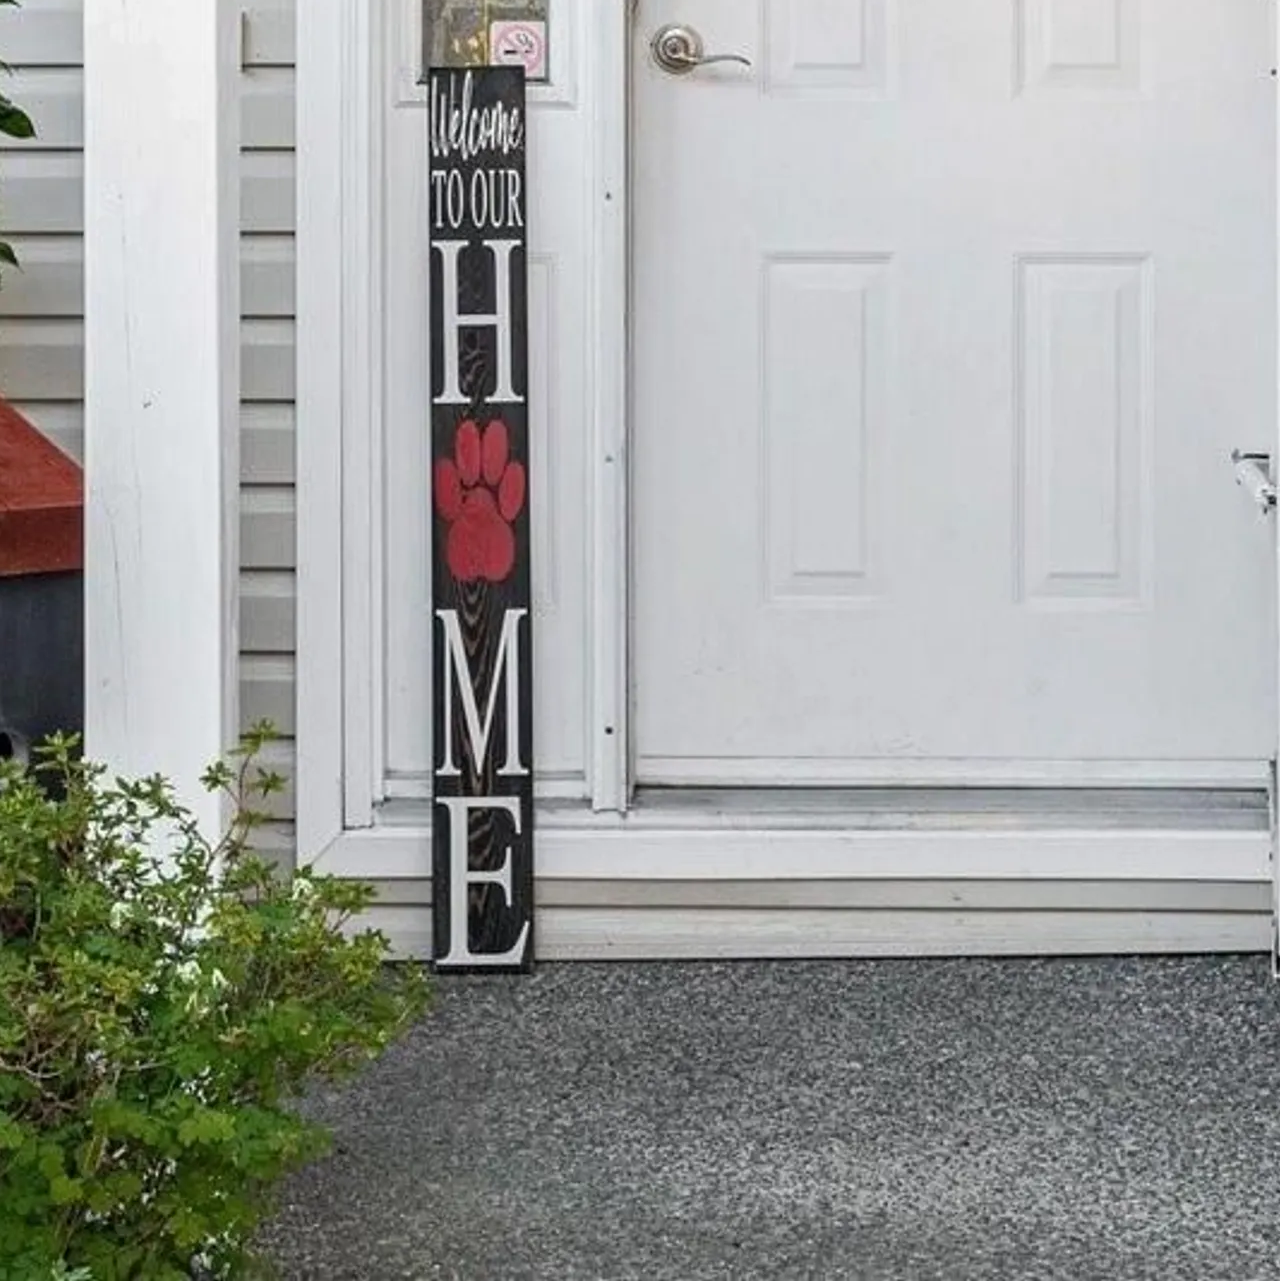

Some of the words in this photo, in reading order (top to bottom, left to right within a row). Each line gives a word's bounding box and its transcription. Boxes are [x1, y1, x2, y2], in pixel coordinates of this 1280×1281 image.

[430, 70, 524, 160] Welcome
[431, 169, 464, 228] TO
[471, 168, 524, 228] OUR
